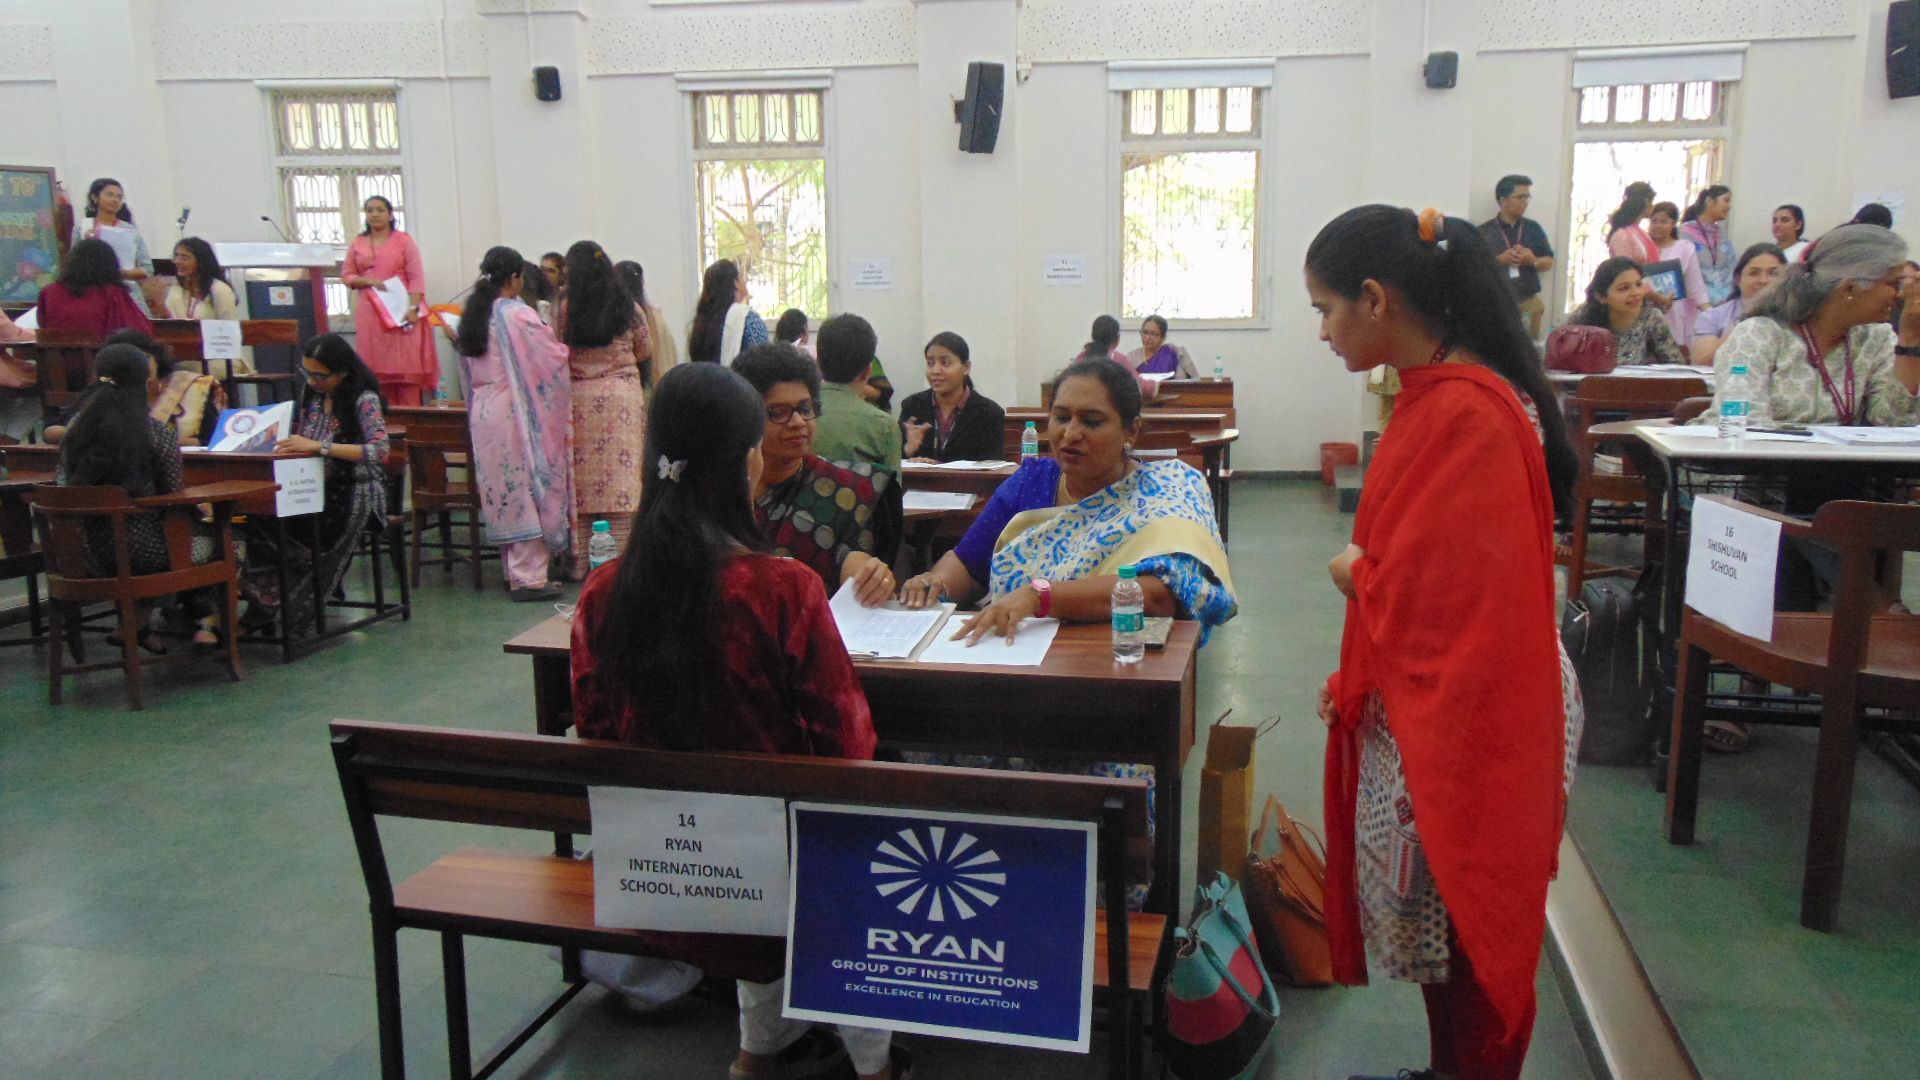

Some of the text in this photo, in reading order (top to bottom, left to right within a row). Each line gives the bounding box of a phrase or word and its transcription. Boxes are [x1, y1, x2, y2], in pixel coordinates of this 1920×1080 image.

[1724, 526, 1734, 538] 16
[1707, 538, 1749, 563] SHISHUVAN
[1710, 559, 1738, 580] SCHOOL
[677, 813, 696, 828] 14
[665, 838, 702, 852] RYAN
[629, 858, 743, 879] INTERNATIONAL
[620, 878, 763, 900] SCHOOL, KANDIVALI
[866, 927, 1005, 963] RYAN
[831, 959, 1039, 990] GROUP OF INSTITUTIONS
[845, 983, 1021, 1009] EXCELLENCE IN EDUCATION
